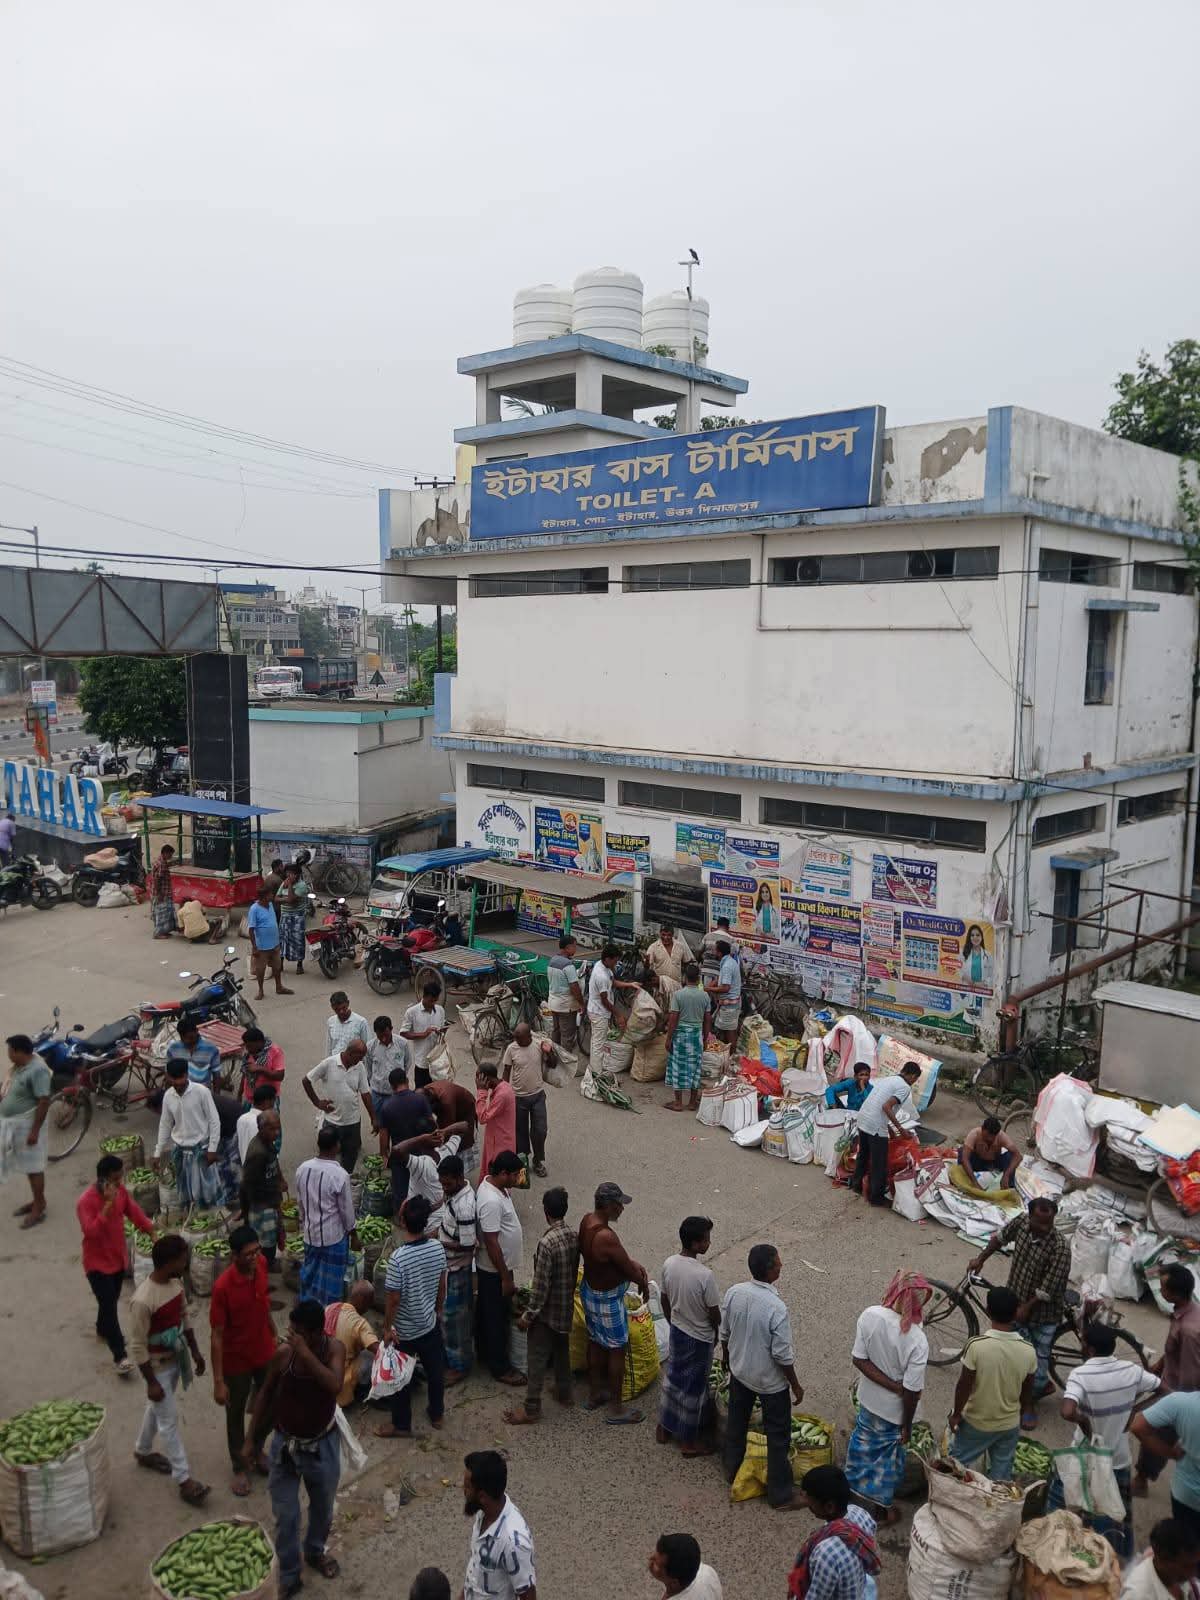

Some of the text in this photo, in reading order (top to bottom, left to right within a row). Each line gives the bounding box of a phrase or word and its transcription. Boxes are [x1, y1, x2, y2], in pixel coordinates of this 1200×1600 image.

[482, 426, 860, 500] ইটাহার বাস টার্মিনাস
[576, 482, 717, 512] TOILET- A
[0, 758, 107, 837] TAHAR
[506, 837, 520, 848] বাস
